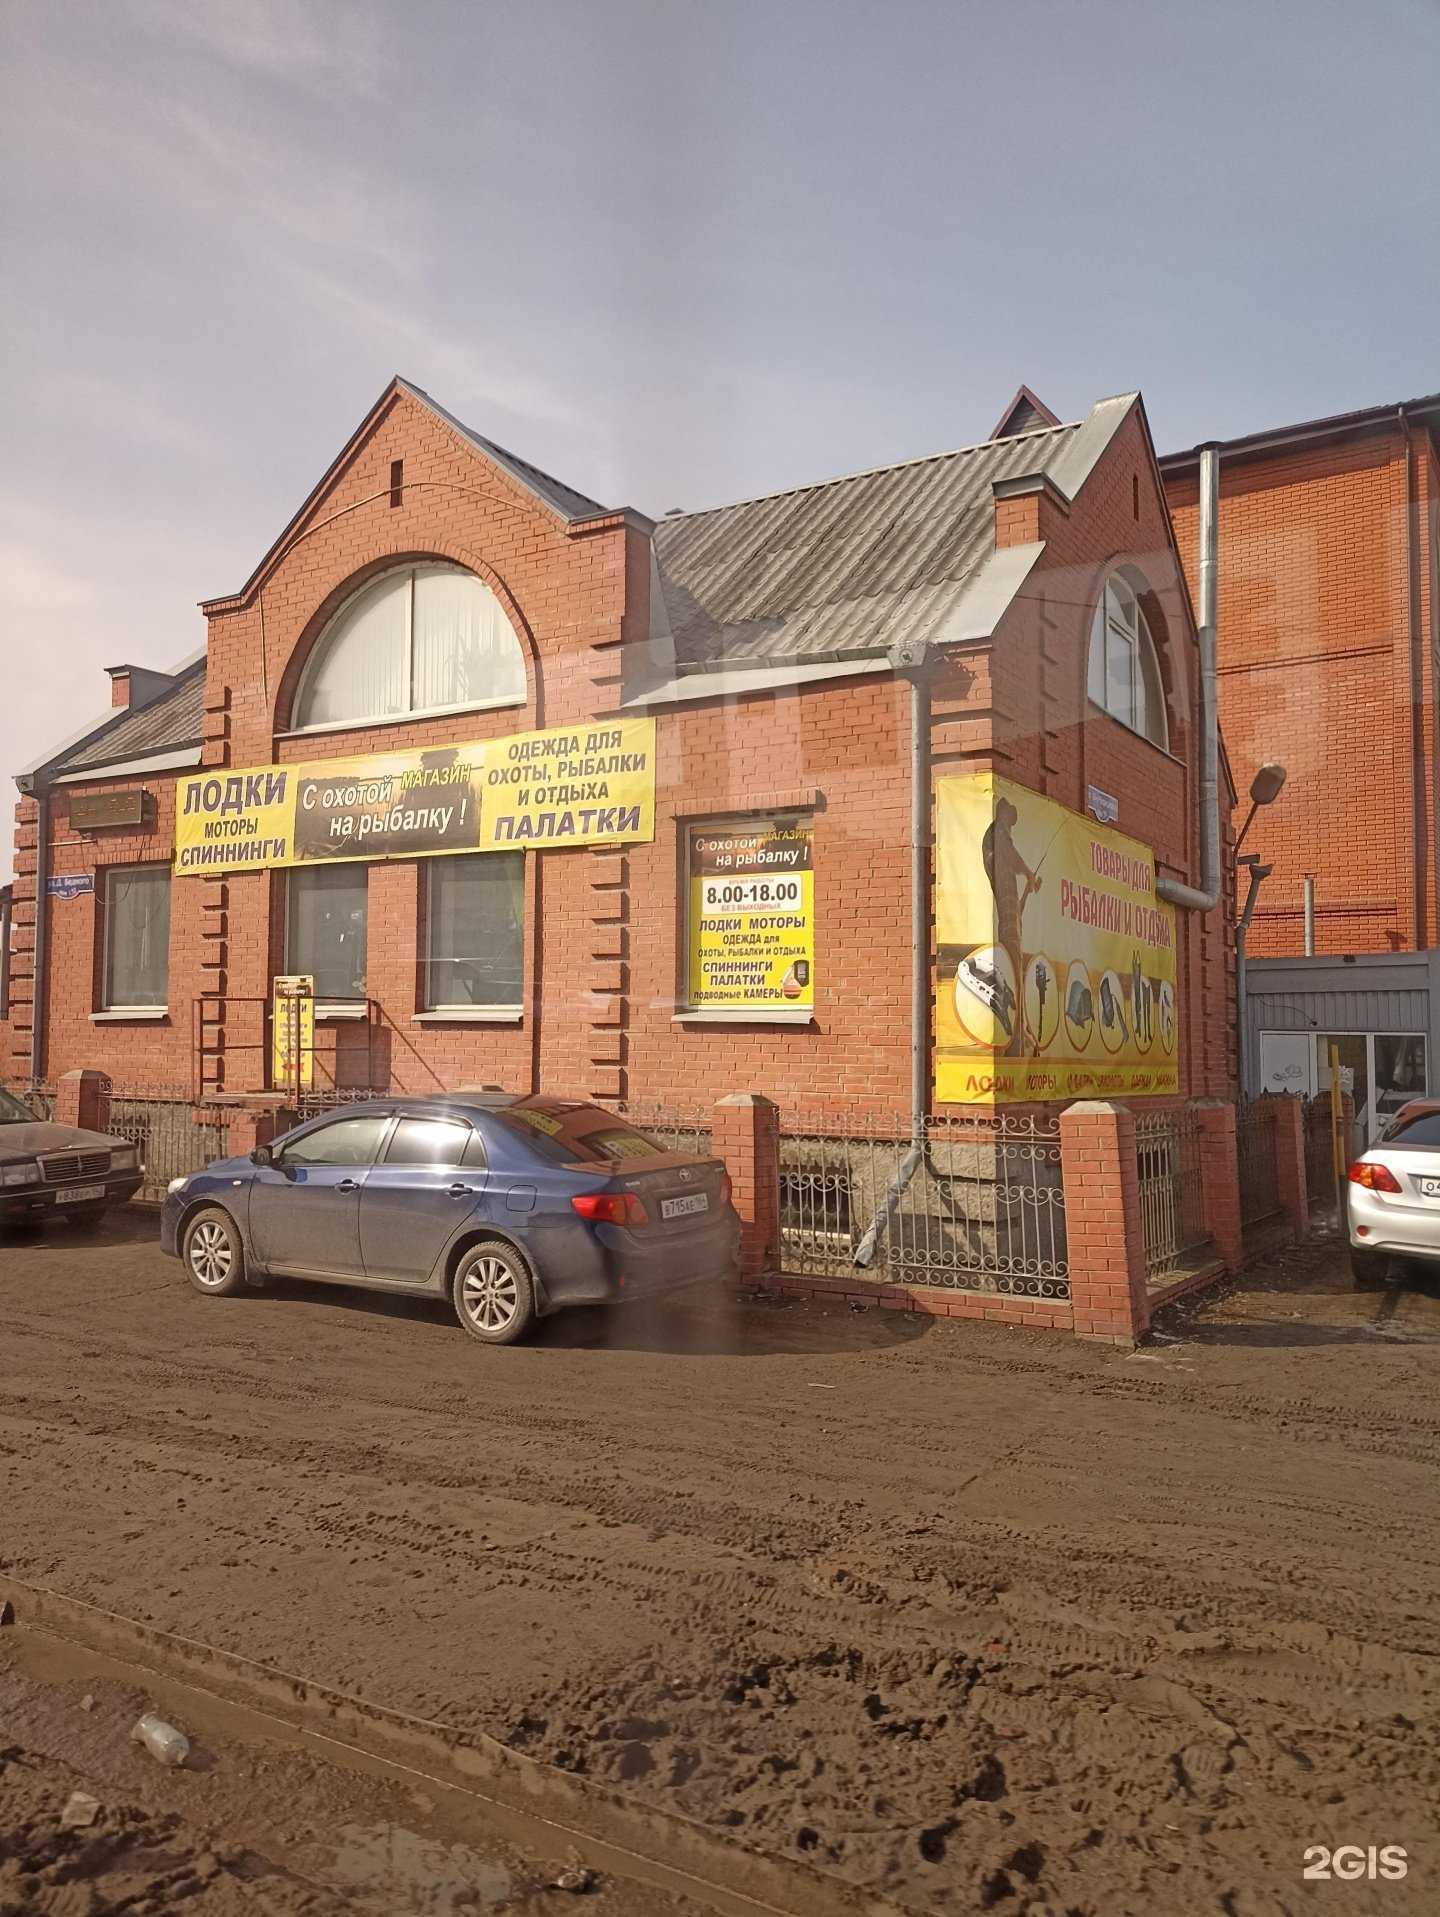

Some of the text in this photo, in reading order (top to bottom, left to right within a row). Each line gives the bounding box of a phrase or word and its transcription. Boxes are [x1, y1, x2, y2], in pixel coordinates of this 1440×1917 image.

[508, 730, 623, 763] ОДЕЖДА ДЛЯ
[401, 764, 471, 790] МАГАЗИН
[488, 753, 647, 786] ОХОТЫ, РЫБАЛКИ
[183, 771, 288, 816] ЛОДКИ
[322, 775, 393, 808] охотой
[518, 782, 609, 807] И ОТДЫХА
[204, 818, 259, 838] МОТОРЫ
[329, 815, 353, 837] на
[494, 806, 641, 841] ПАЛАТКИ
[181, 838, 286, 866] СПИННИНГИ
[716, 854, 733, 867] на
[736, 849, 800, 868] рыбалку
[1090, 841, 1152, 893] ТОВАРЫ ДЛЯ
[707, 882, 798, 904] 8.00-18.00
[698, 916, 806, 933] ЛОДКИ МОТОРЫ
[1060, 880, 1172, 950] РЫБАЛКИ И ОТДЫХА
[722, 933, 762, 946] ОДЕЖДА
[773, 944, 807, 956] ОТДЫХА
[703, 960, 773, 973] СПИННИНГИ
[709, 974, 766, 986] ПАЛАТКИ
[743, 987, 783, 999] КАМЕРЫ
